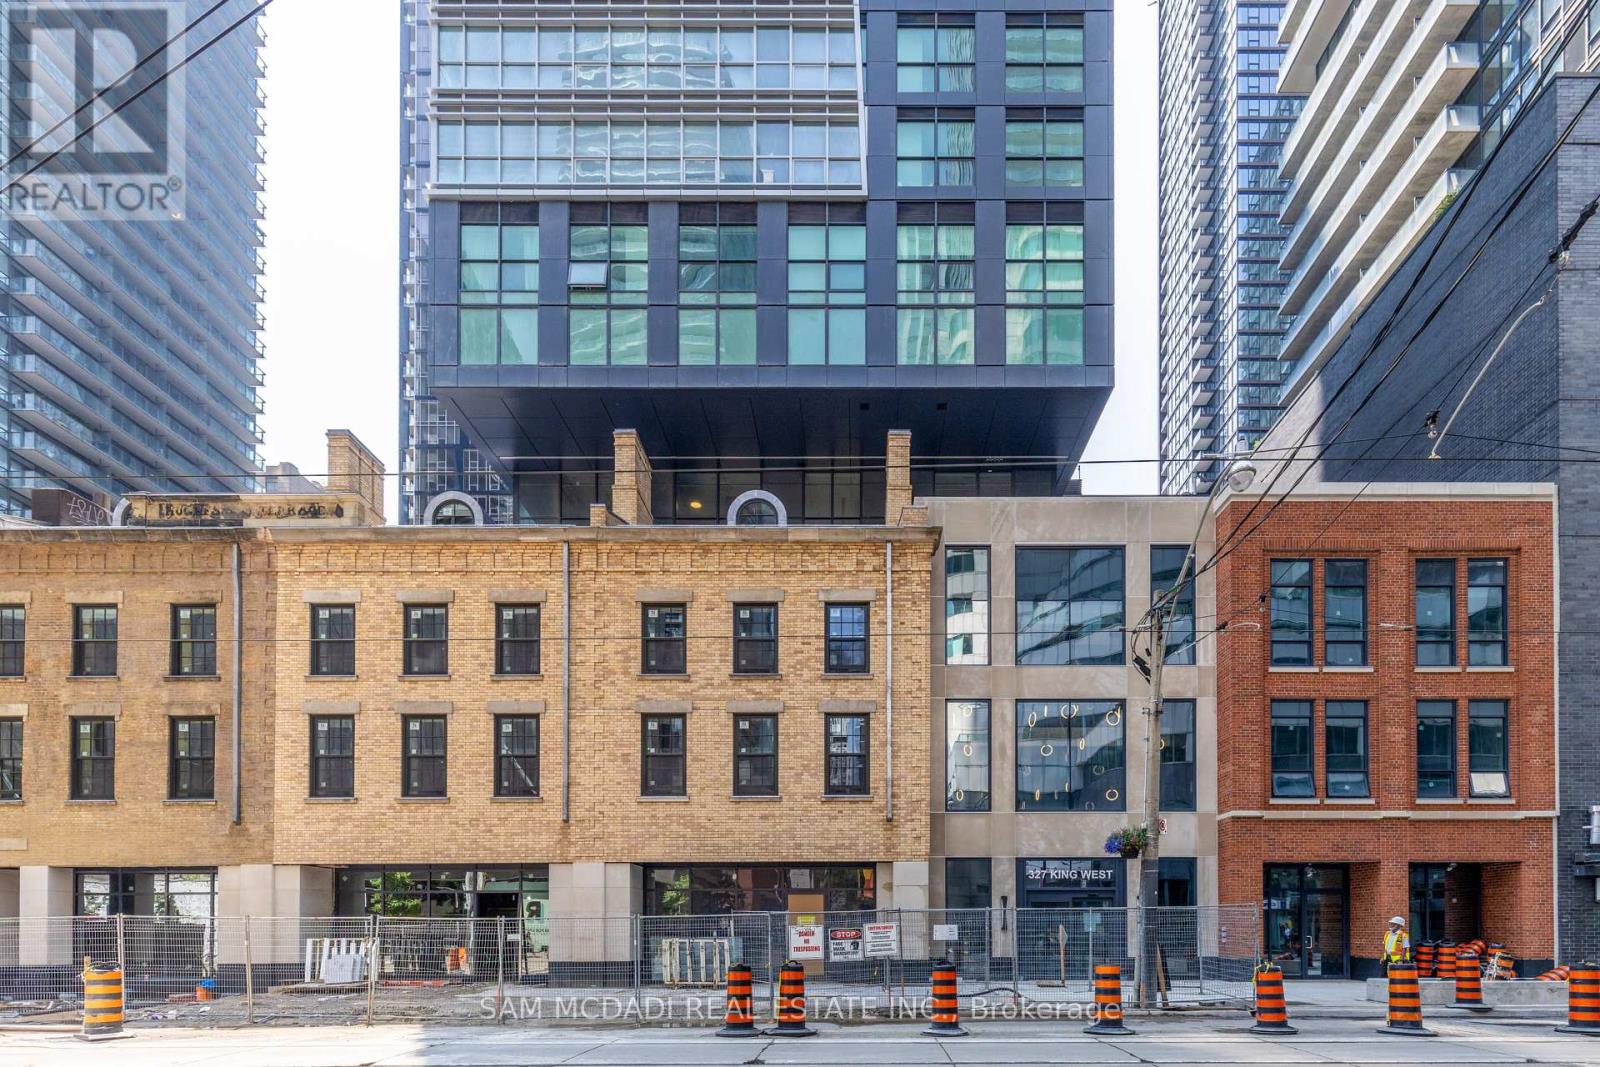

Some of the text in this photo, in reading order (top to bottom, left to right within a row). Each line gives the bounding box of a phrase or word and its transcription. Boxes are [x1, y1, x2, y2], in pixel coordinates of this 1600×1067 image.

[1028, 870, 1113, 879] 327 KING WEST
